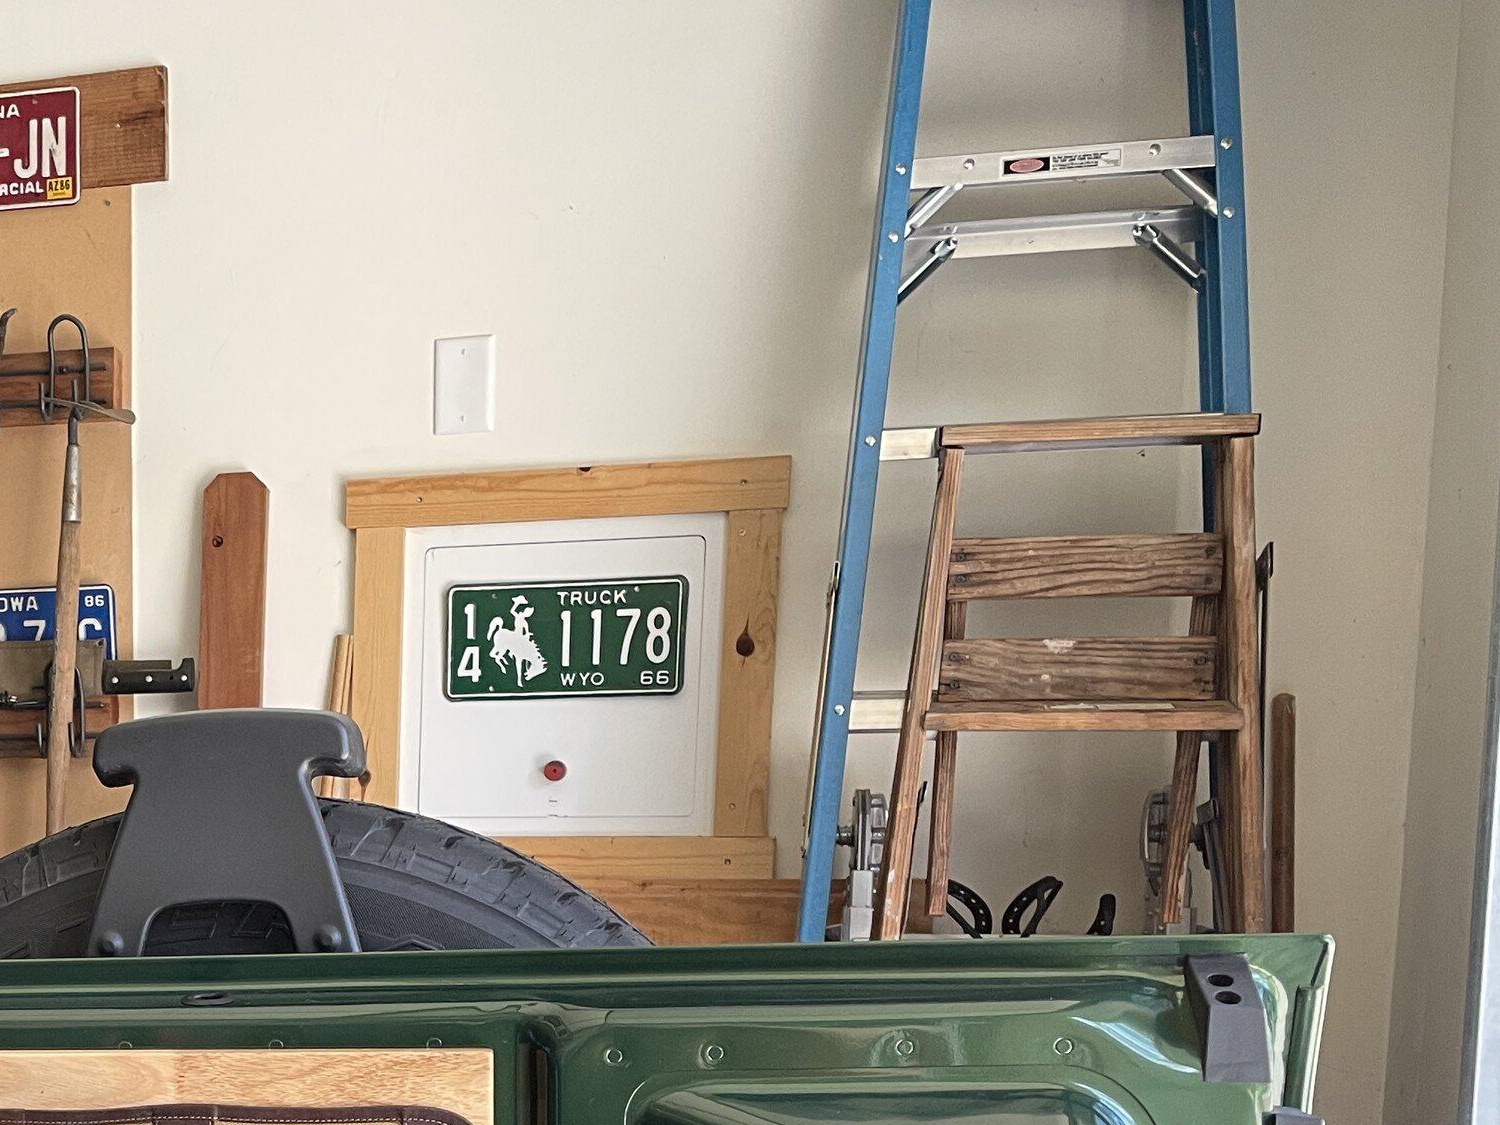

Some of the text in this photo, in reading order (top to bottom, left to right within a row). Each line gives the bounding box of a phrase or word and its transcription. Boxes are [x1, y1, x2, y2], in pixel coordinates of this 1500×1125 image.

[84, 595, 105, 607] 86
[557, 589, 627, 606] TRUCK
[560, 607, 672, 667] 1178
[560, 671, 670, 687] WYO 66
